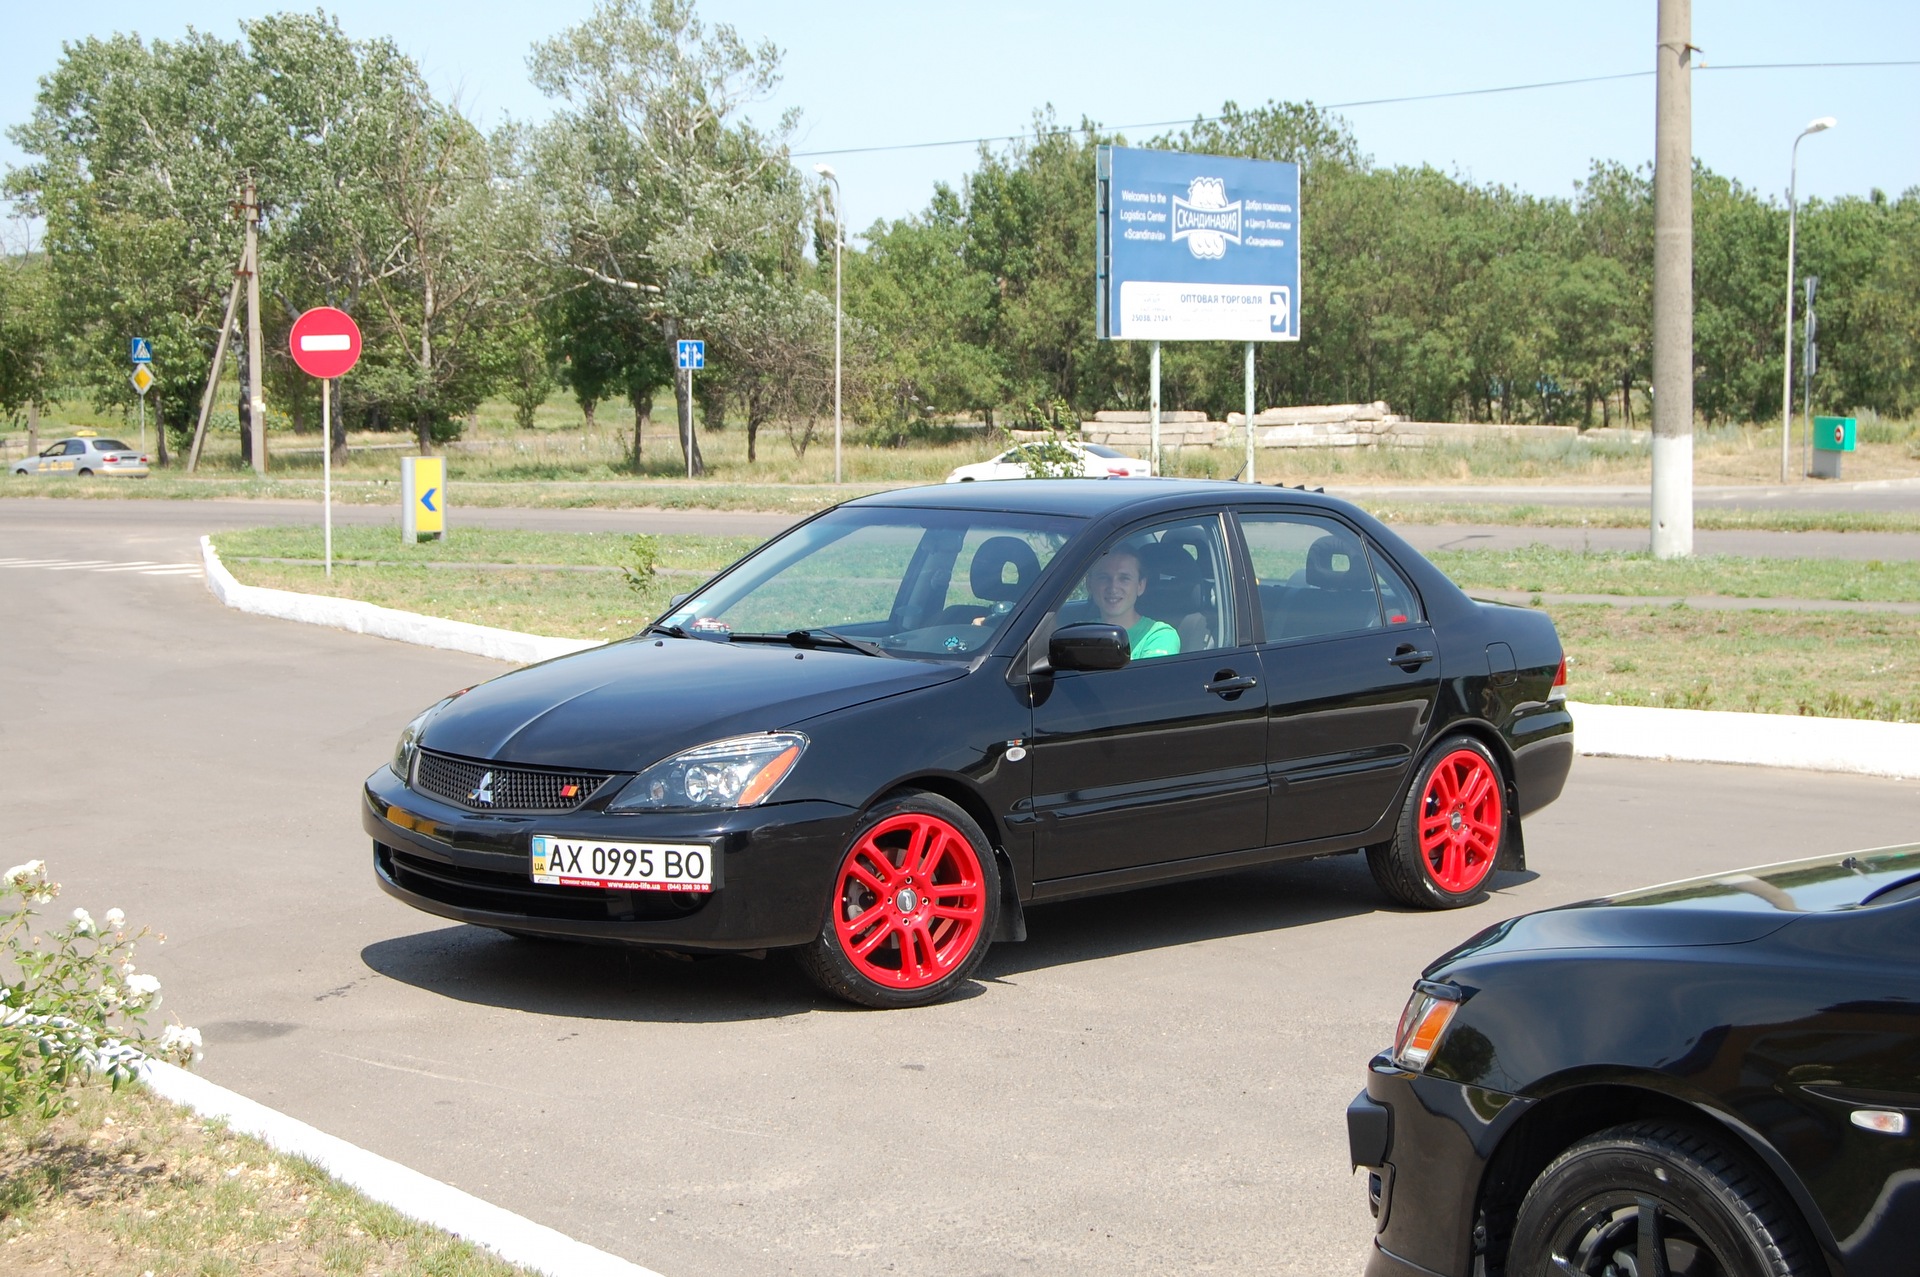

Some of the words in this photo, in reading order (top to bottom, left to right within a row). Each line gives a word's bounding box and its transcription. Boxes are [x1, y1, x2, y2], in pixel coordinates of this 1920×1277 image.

[1121, 190, 1149, 202] Welcome
[1150, 192, 1156, 202] to
[1157, 193, 1166, 203] the
[1120, 209, 1146, 222] Logistics
[1147, 210, 1166, 222] Center
[1177, 208, 1237, 231] СКАНДИНАВИЯ
[1180, 293, 1219, 304] ОПТОВАЯ
[1221, 294, 1263, 305] ТОРГОВЛЯ
[534, 862, 545, 872] UA
[549, 844, 583, 874] AX
[592, 847, 654, 878] 0995
[665, 850, 704, 879] BO
[607, 881, 661, 890] www.auto-life.ua
[667, 883, 681, 891] (044)
